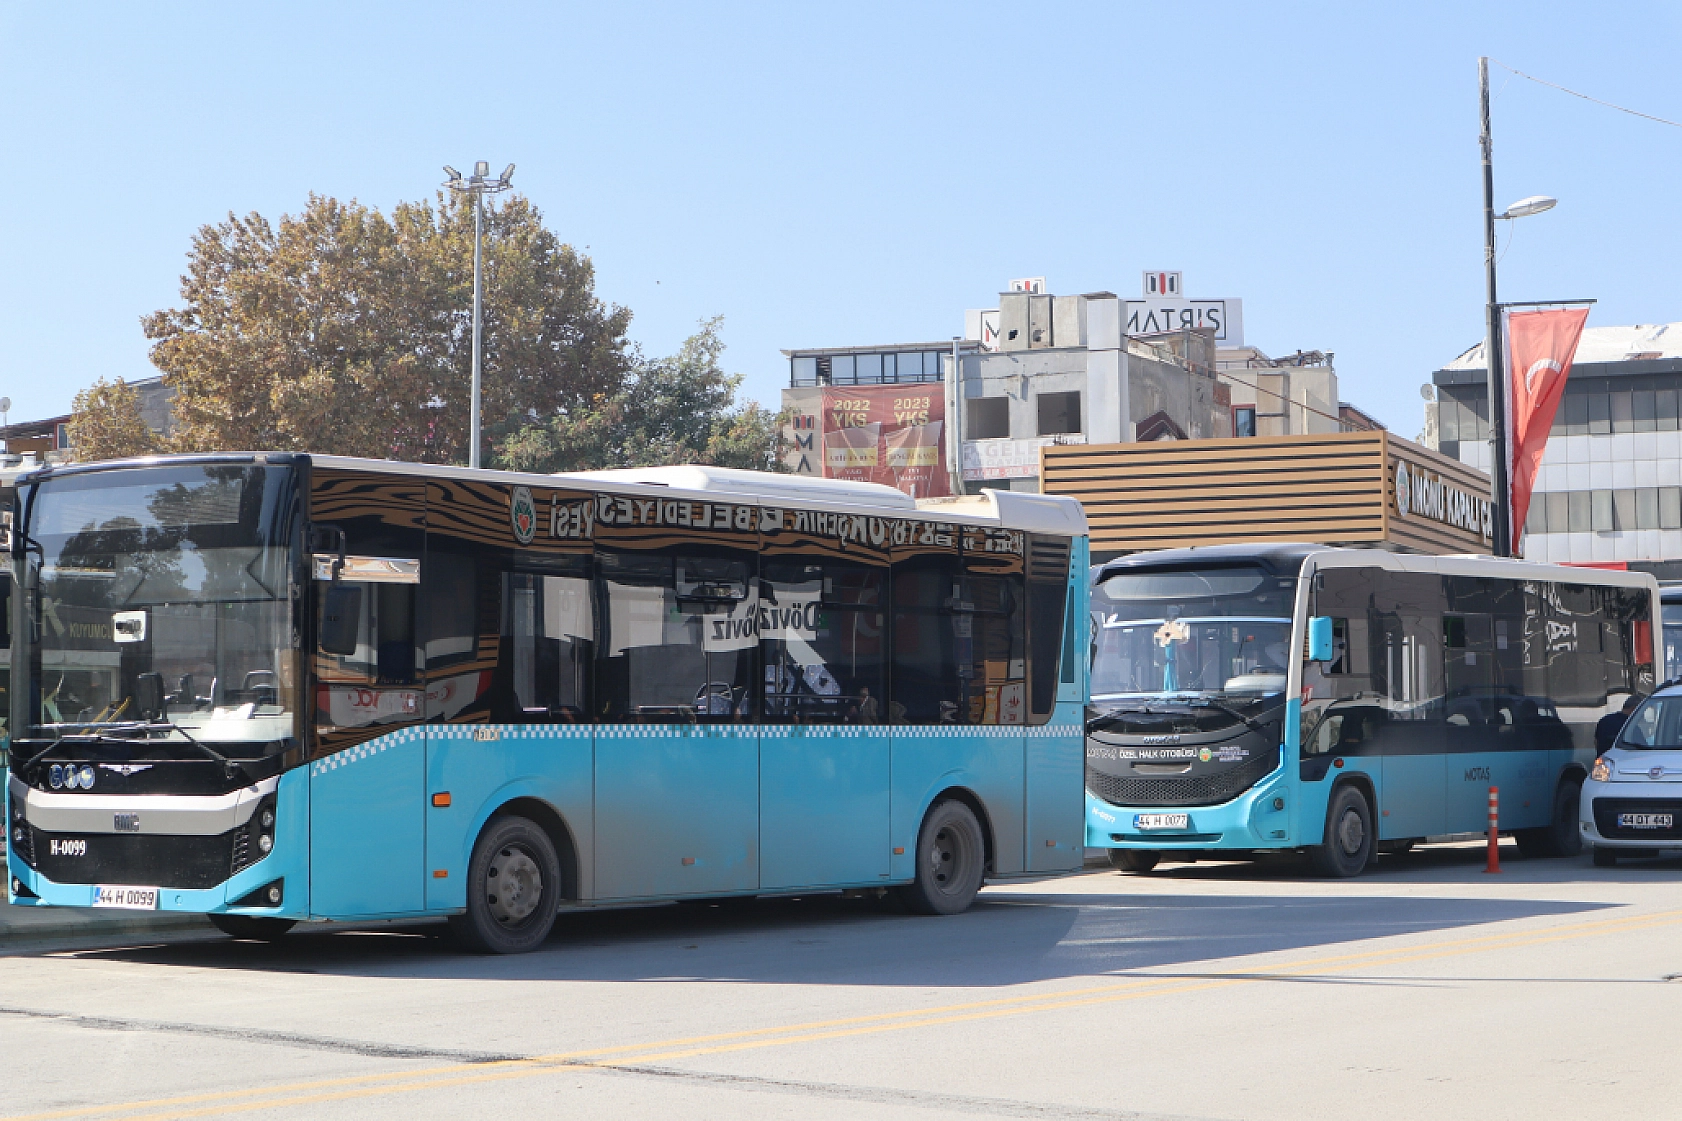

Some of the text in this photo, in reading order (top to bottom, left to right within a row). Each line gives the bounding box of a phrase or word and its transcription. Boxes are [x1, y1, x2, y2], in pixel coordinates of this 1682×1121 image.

[833, 399, 870, 411] 2022
[893, 396, 931, 410] 2023
[832, 411, 867, 428] YKS
[893, 409, 929, 427] YKS
[1138, 748, 1158, 759] HALK
[1139, 815, 1186, 826] 44 H 0077
[1623, 814, 1634, 824] 44
[50, 839, 86, 857] H-0099
[99, 888, 155, 906] 44 H 0099
